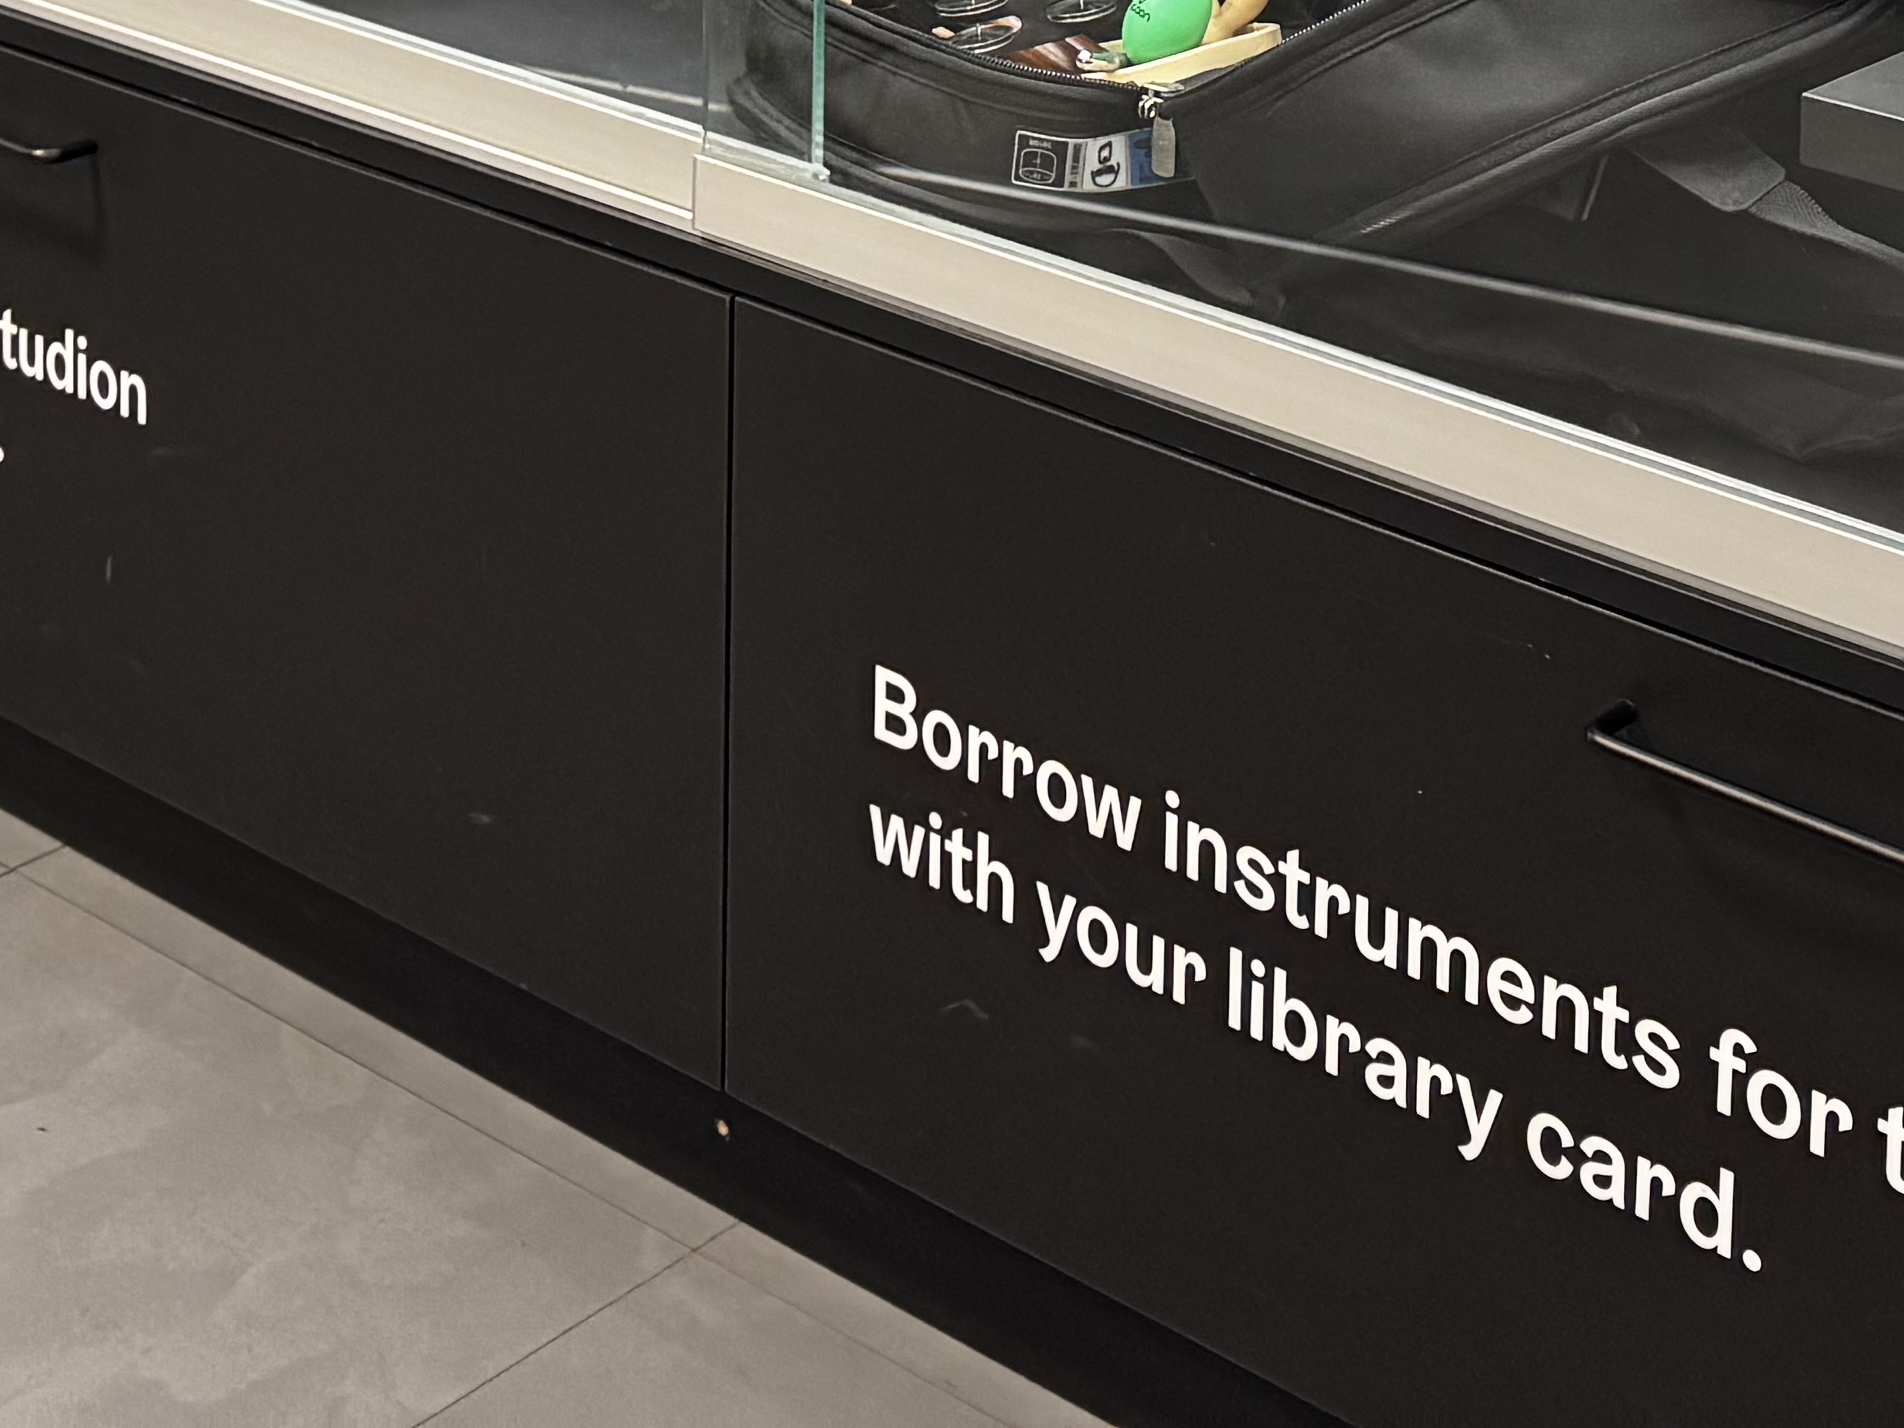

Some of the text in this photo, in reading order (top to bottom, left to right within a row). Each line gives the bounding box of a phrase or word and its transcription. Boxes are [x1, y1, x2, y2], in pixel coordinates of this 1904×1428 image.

[869, 796, 1762, 1272] with your library card.
[873, 664, 1142, 852] Borrow
[1164, 791, 1681, 1089] instruments
[1709, 1028, 1854, 1158] for
